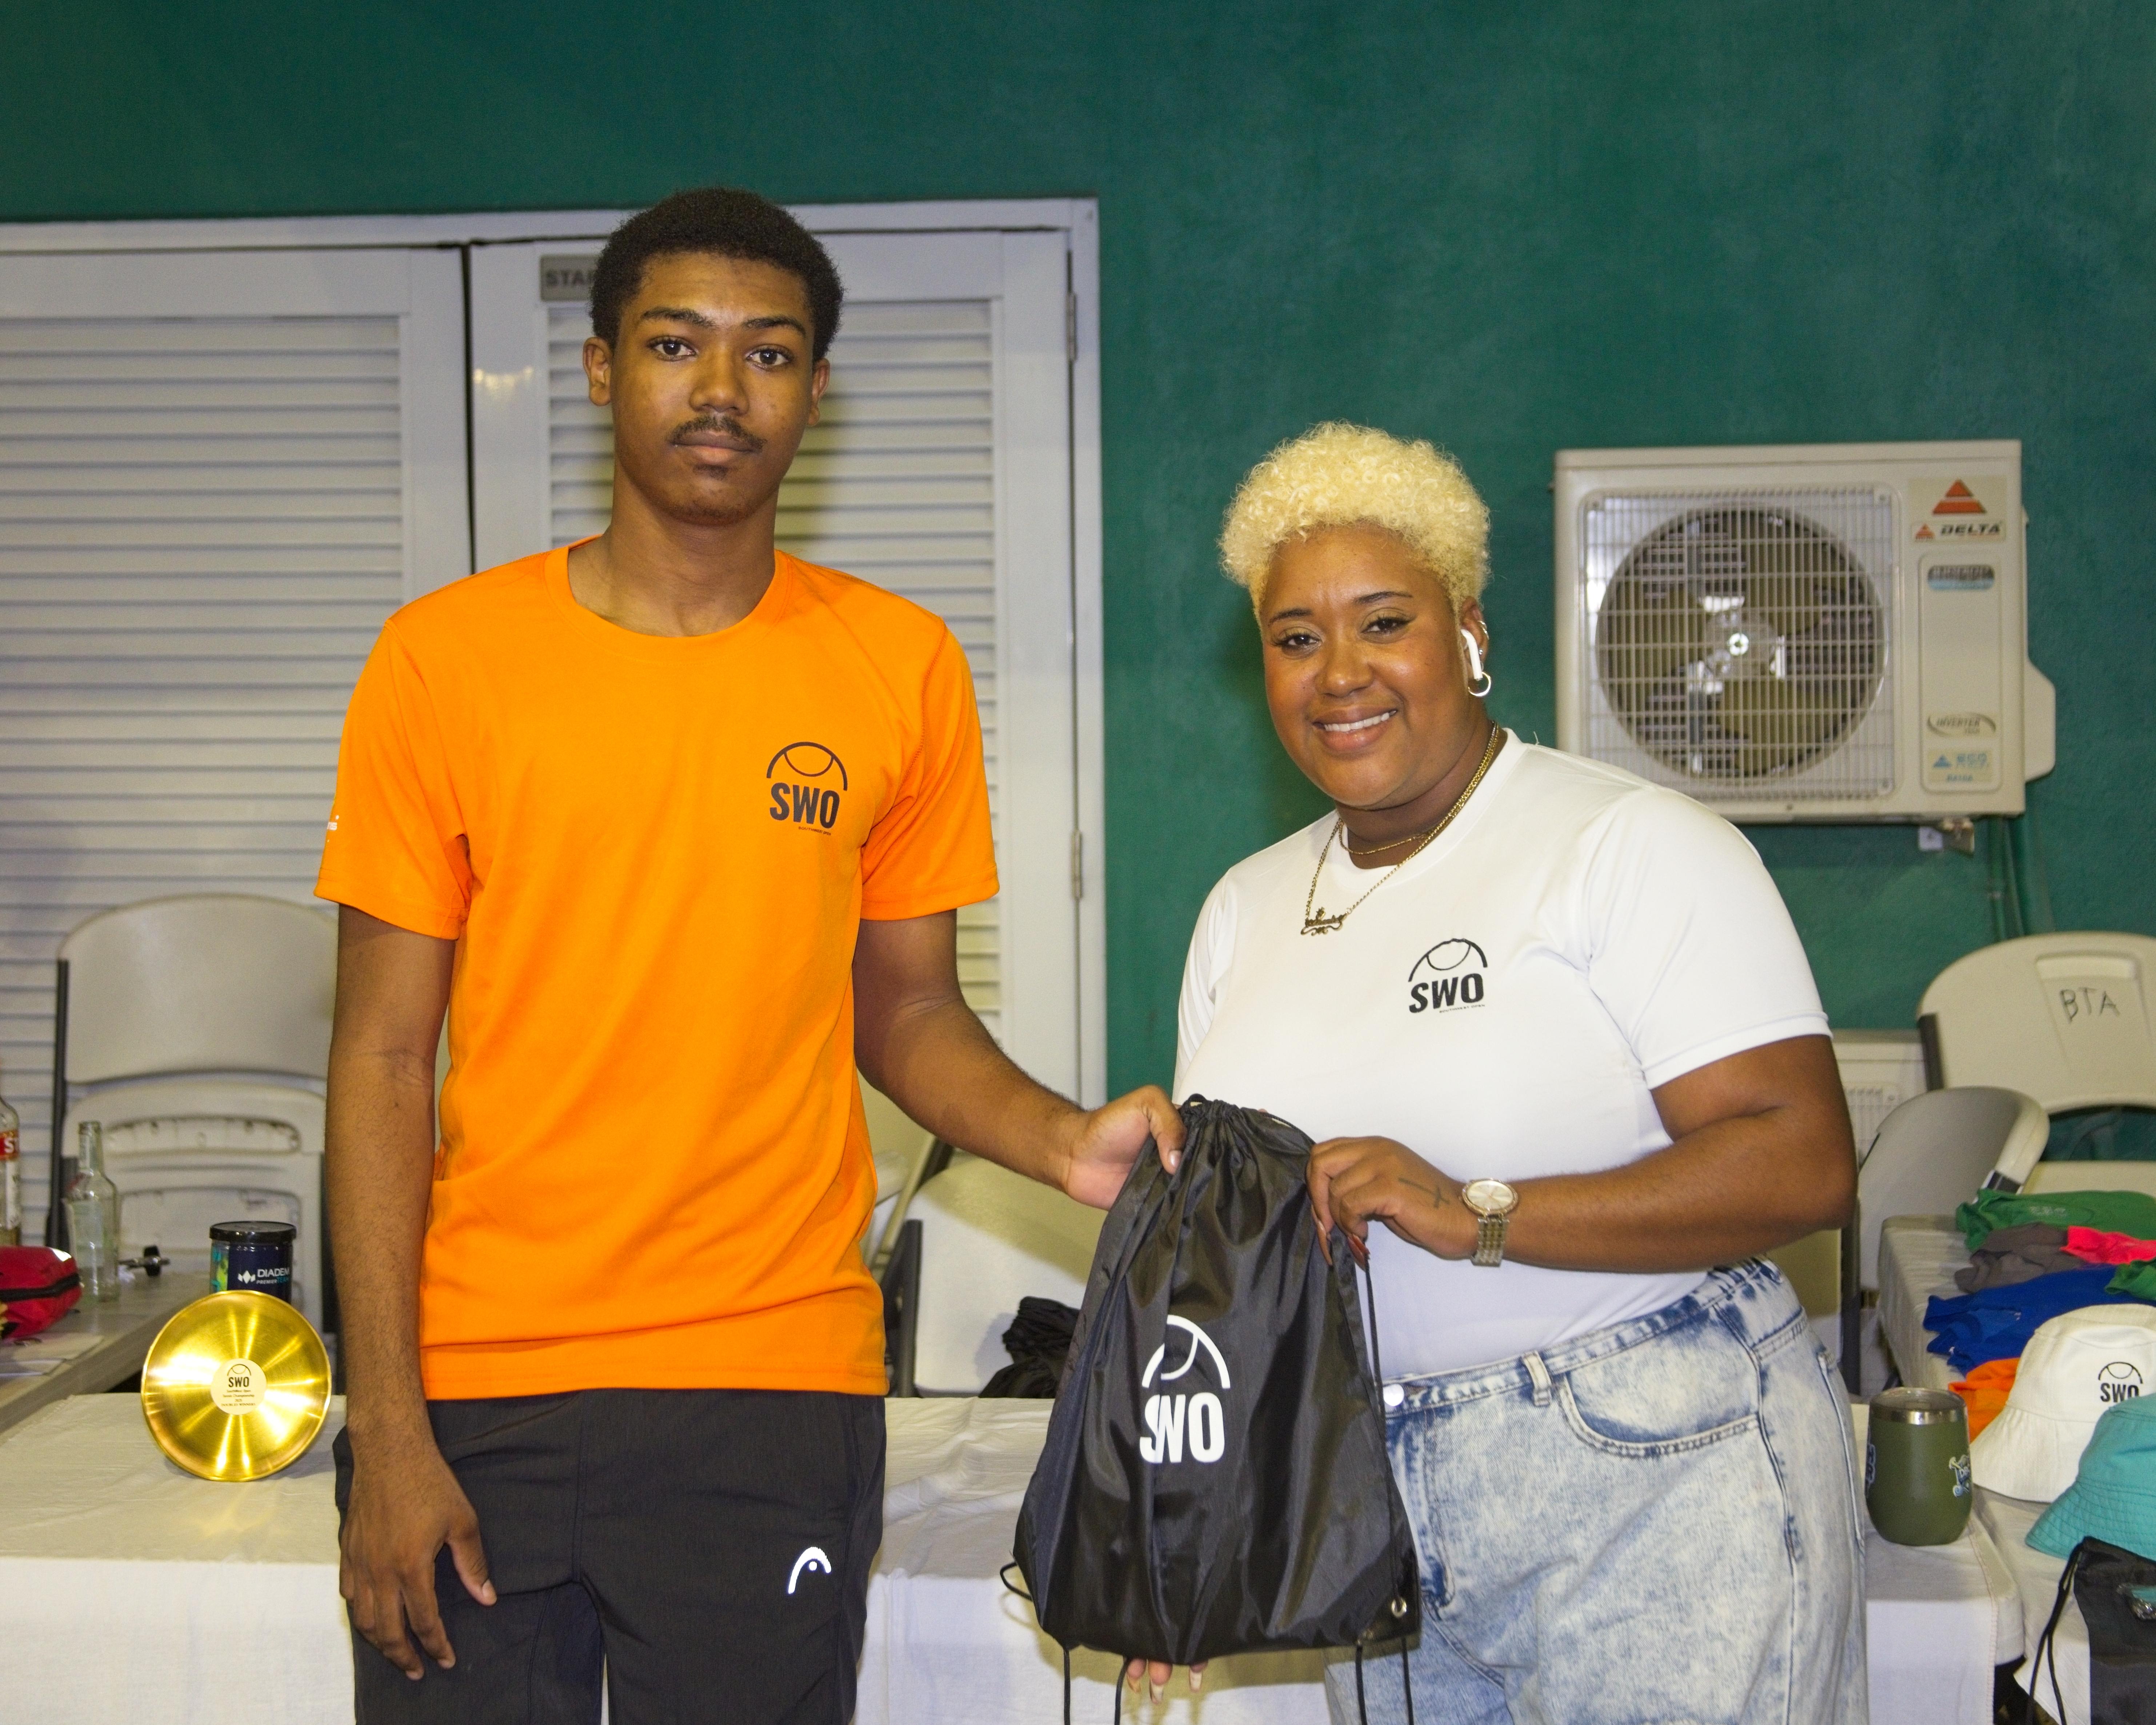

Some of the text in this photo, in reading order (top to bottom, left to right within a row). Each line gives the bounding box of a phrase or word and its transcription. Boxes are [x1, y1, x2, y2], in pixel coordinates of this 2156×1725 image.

[1941, 524, 2000, 535] DELTA
[770, 783, 840, 828] SWO
[1409, 973, 1484, 1013] SWO
[2060, 987, 2120, 1025] BTA
[228, 1377, 249, 1387] SWO
[2100, 1382, 2139, 1402] SWO
